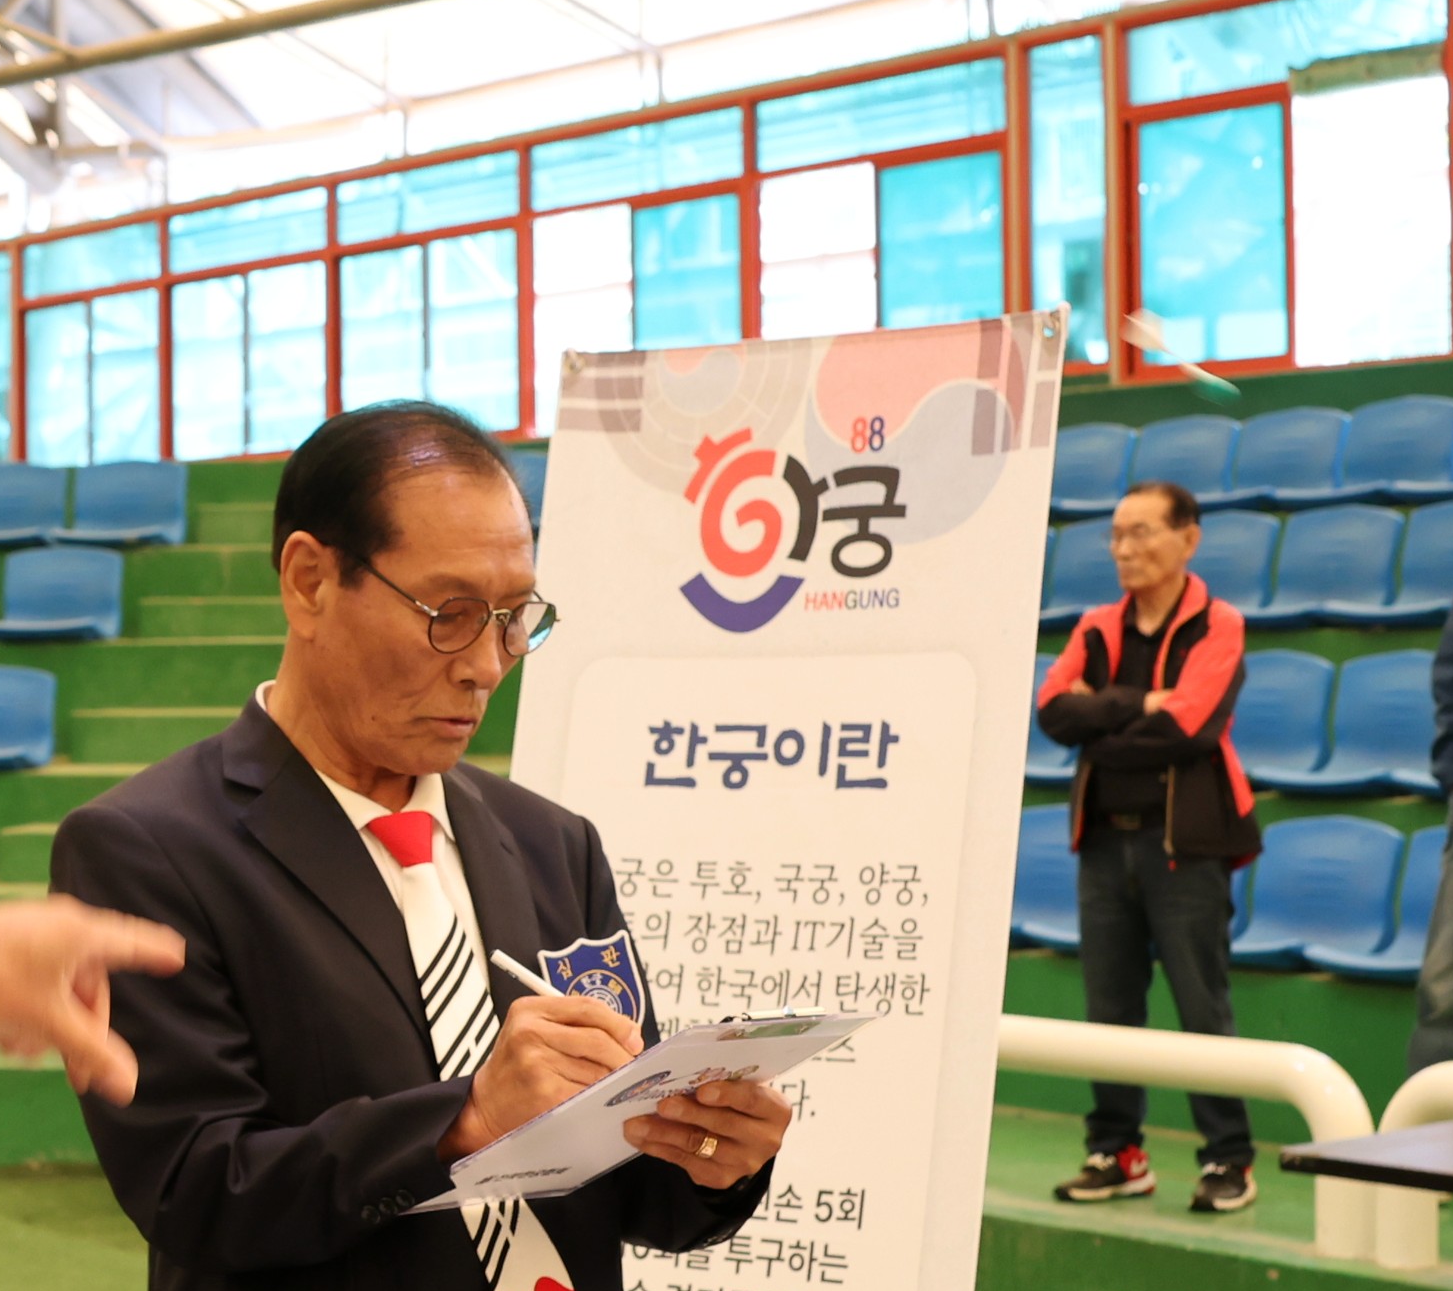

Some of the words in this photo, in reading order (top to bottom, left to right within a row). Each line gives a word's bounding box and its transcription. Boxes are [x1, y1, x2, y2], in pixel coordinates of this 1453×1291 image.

[851, 416, 885, 453] 88
[804, 588, 900, 611] HANGUNG
[643, 719, 900, 790] 한궁이란
[616, 857, 679, 899] 궁은
[690, 860, 762, 905] 투호,
[775, 863, 846, 907] 국궁,
[859, 862, 929, 907] 양궁,
[684, 912, 782, 956] 장점과
[791, 916, 924, 961] IT기술을
[647, 963, 684, 1004] 여
[696, 966, 823, 1009] 한국에서
[835, 971, 931, 1016] 탄생한
[814, 1188, 866, 1230] 5회
[724, 1235, 849, 1285] 투구하는
